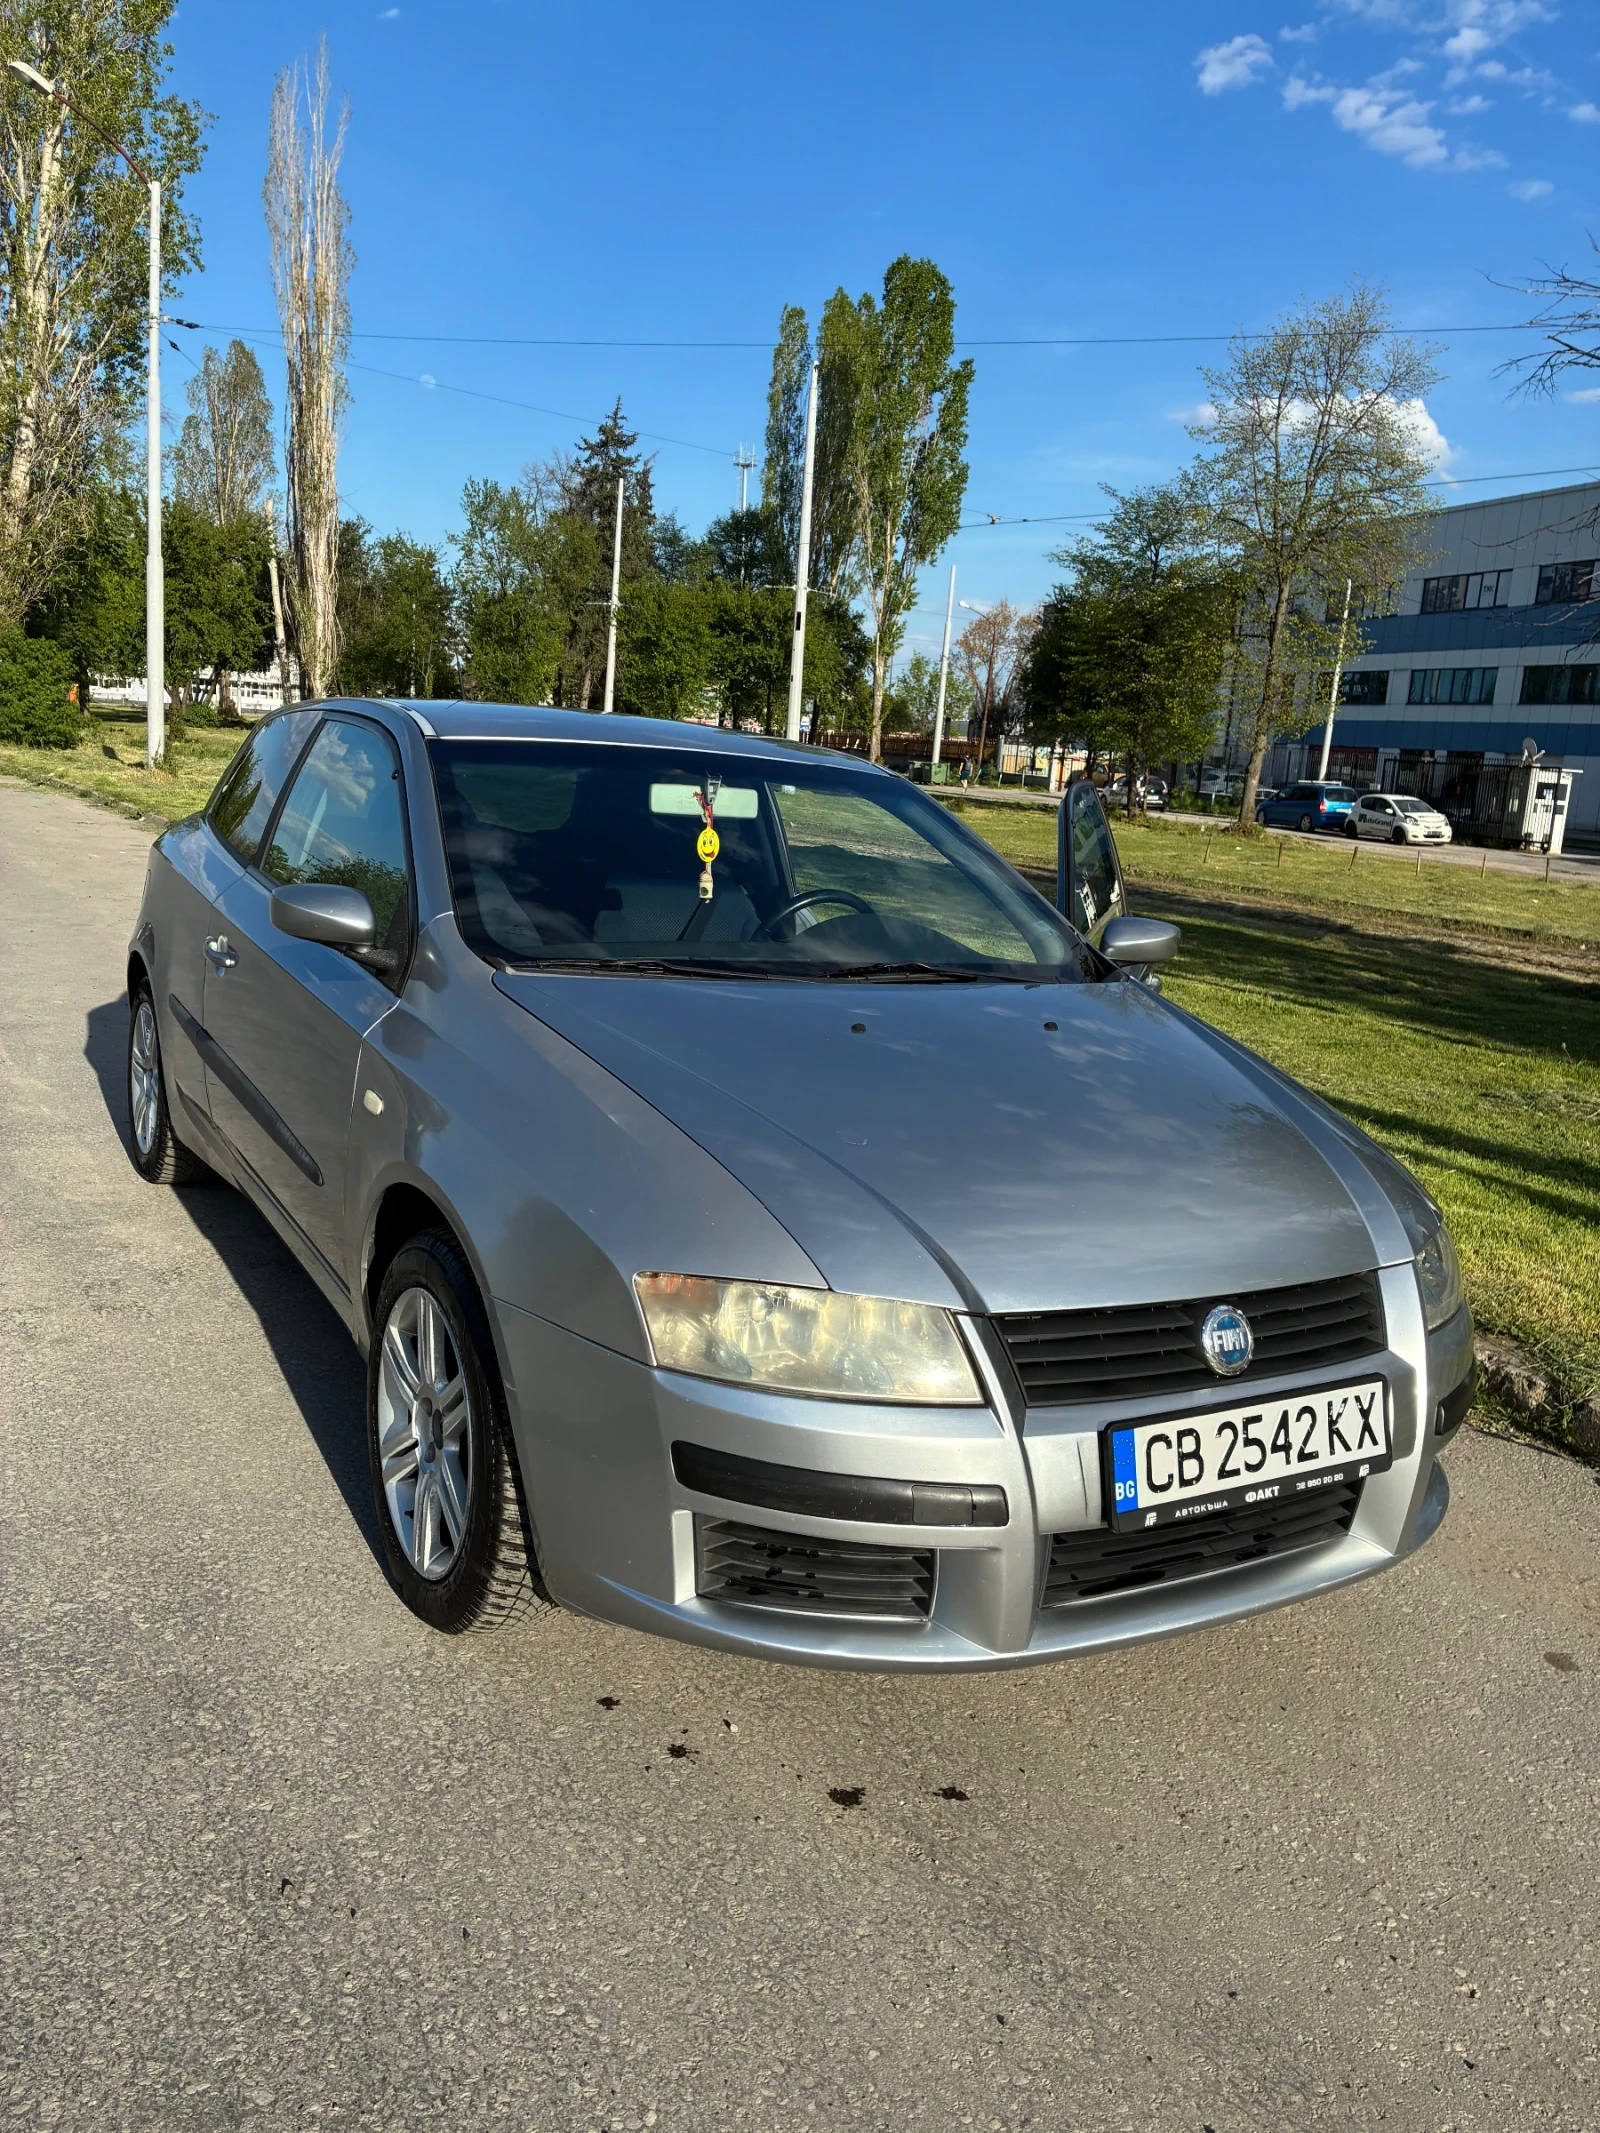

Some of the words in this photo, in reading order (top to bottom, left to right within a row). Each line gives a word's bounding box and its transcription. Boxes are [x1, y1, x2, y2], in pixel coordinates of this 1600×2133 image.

[1212, 1327, 1245, 1353] FIAT
[1145, 1427, 1205, 1494] CB
[1215, 1405, 1320, 1481] 2542
[1327, 1391, 1380, 1457] KX
[1323, 1475, 1333, 1484] 20
[1334, 1473, 1344, 1482] 20
[1115, 1480, 1135, 1501] BG
[1245, 1485, 1280, 1502] ФАКТ
[1175, 1500, 1228, 1518] АВТОКЪША
